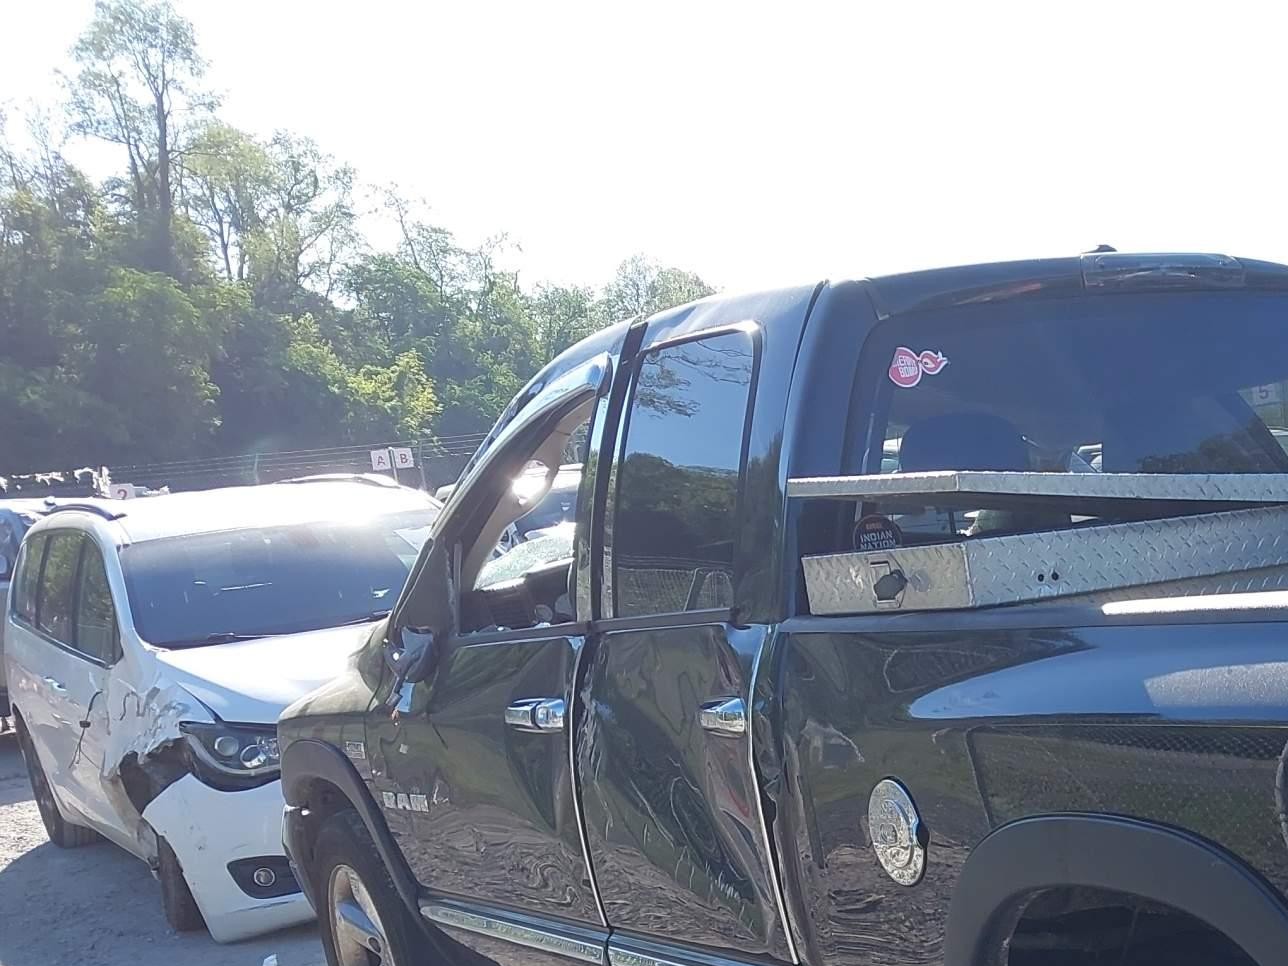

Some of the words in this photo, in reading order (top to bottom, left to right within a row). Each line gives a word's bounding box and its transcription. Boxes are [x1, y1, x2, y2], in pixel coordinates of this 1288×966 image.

[376, 455, 386, 466] A
[399, 453, 408, 464] B
[860, 529, 893, 543] INDIAN
[860, 539, 896, 550] NATION
